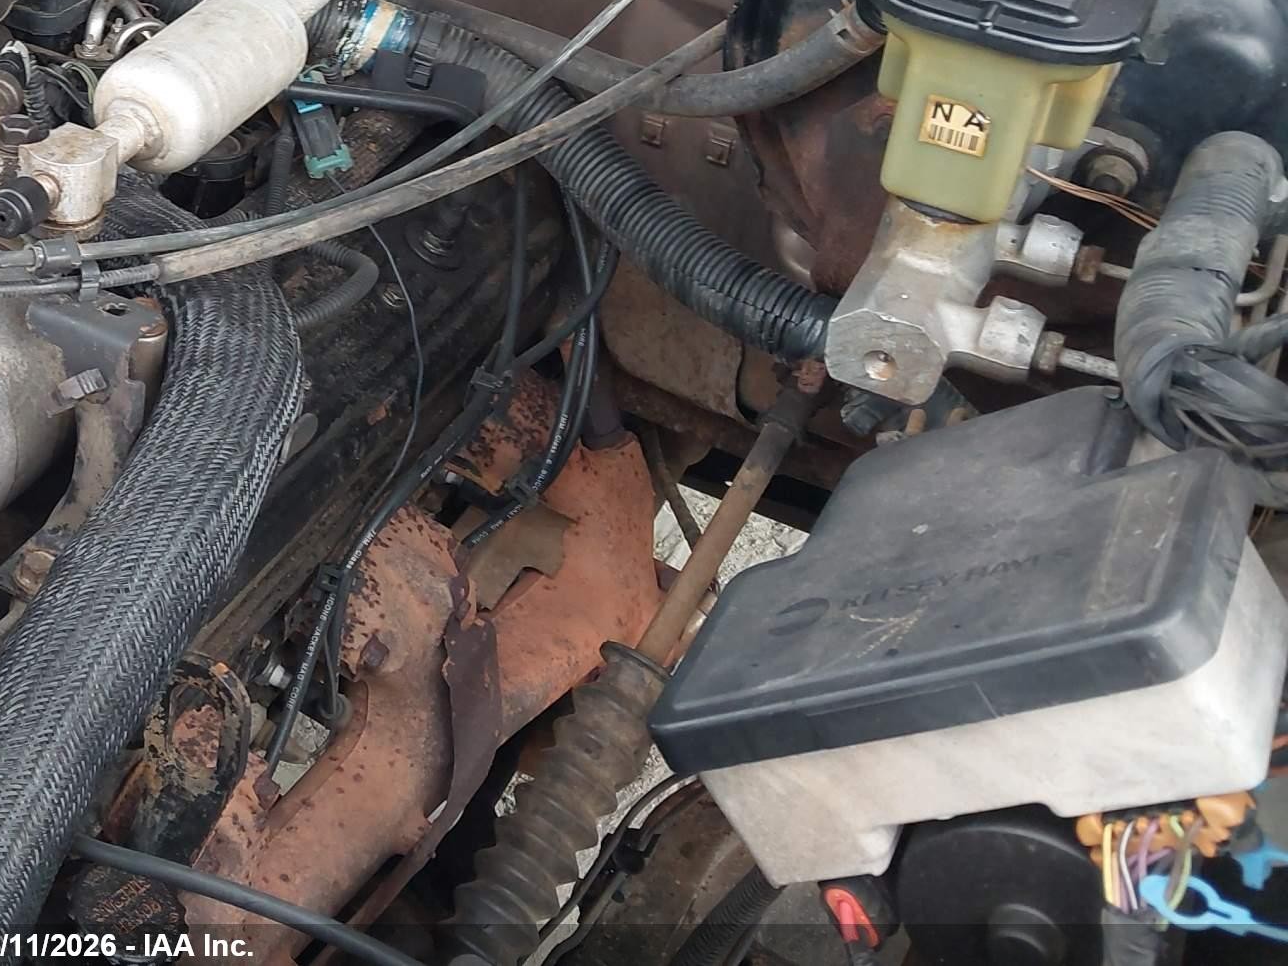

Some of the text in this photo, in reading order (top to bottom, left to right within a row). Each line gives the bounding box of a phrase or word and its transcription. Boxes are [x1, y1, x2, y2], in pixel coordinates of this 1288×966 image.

[931, 101, 985, 132] N A
[305, 626, 322, 656] JACKET
